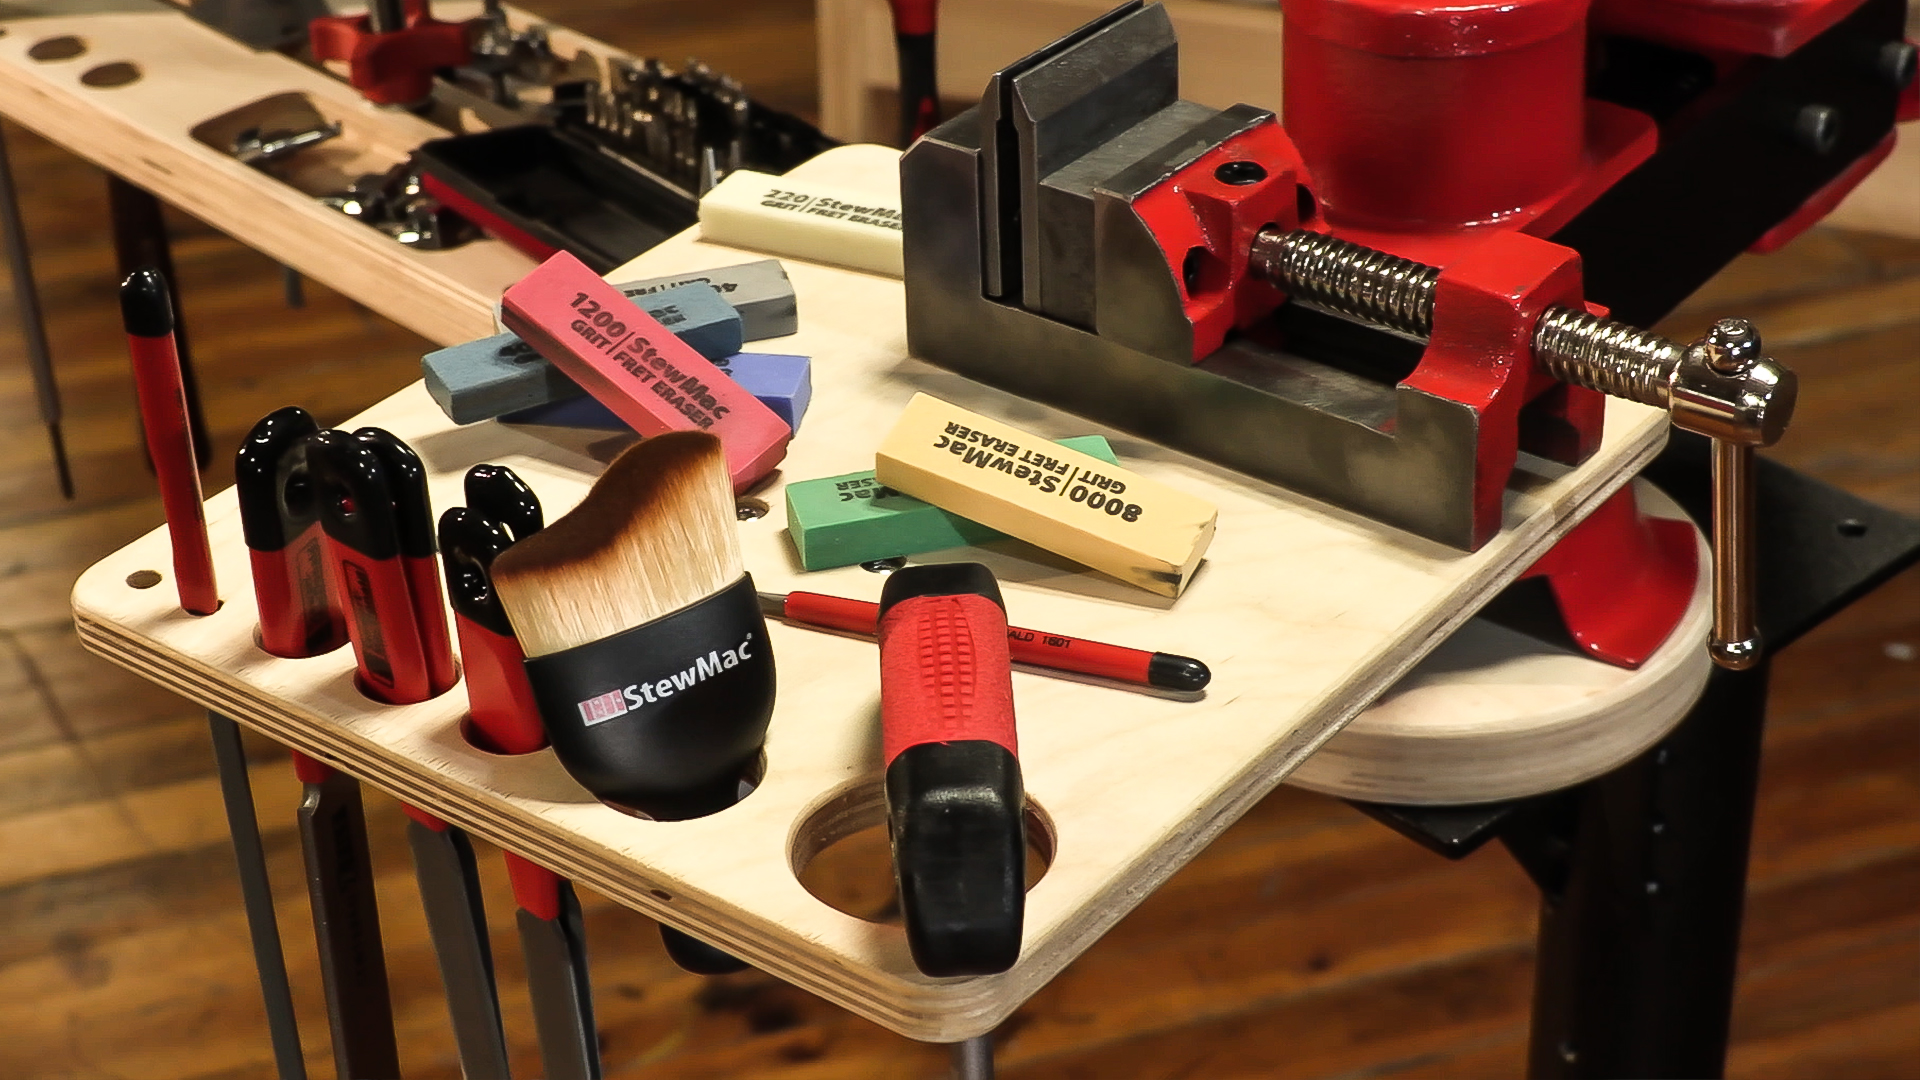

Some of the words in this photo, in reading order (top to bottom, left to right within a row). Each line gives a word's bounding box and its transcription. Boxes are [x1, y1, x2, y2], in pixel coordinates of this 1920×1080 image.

[760, 200, 800, 211] GRIT
[806, 207, 848, 219] FRET
[846, 214, 903, 231] ERASE
[763, 189, 809, 203] 220
[815, 198, 902, 220] StewMa
[570, 292, 627, 337] 1200
[626, 336, 730, 420] StewMac
[570, 319, 612, 349] GRIT
[613, 350, 657, 383] FRET
[650, 380, 714, 430] ERASER
[944, 421, 1020, 457] ERASER
[933, 434, 1062, 493] StewMac
[1018, 449, 1070, 476] FRET
[1077, 470, 1126, 494] GRIT
[1069, 485, 1143, 522] 8000
[622, 640, 753, 711] StewMac
